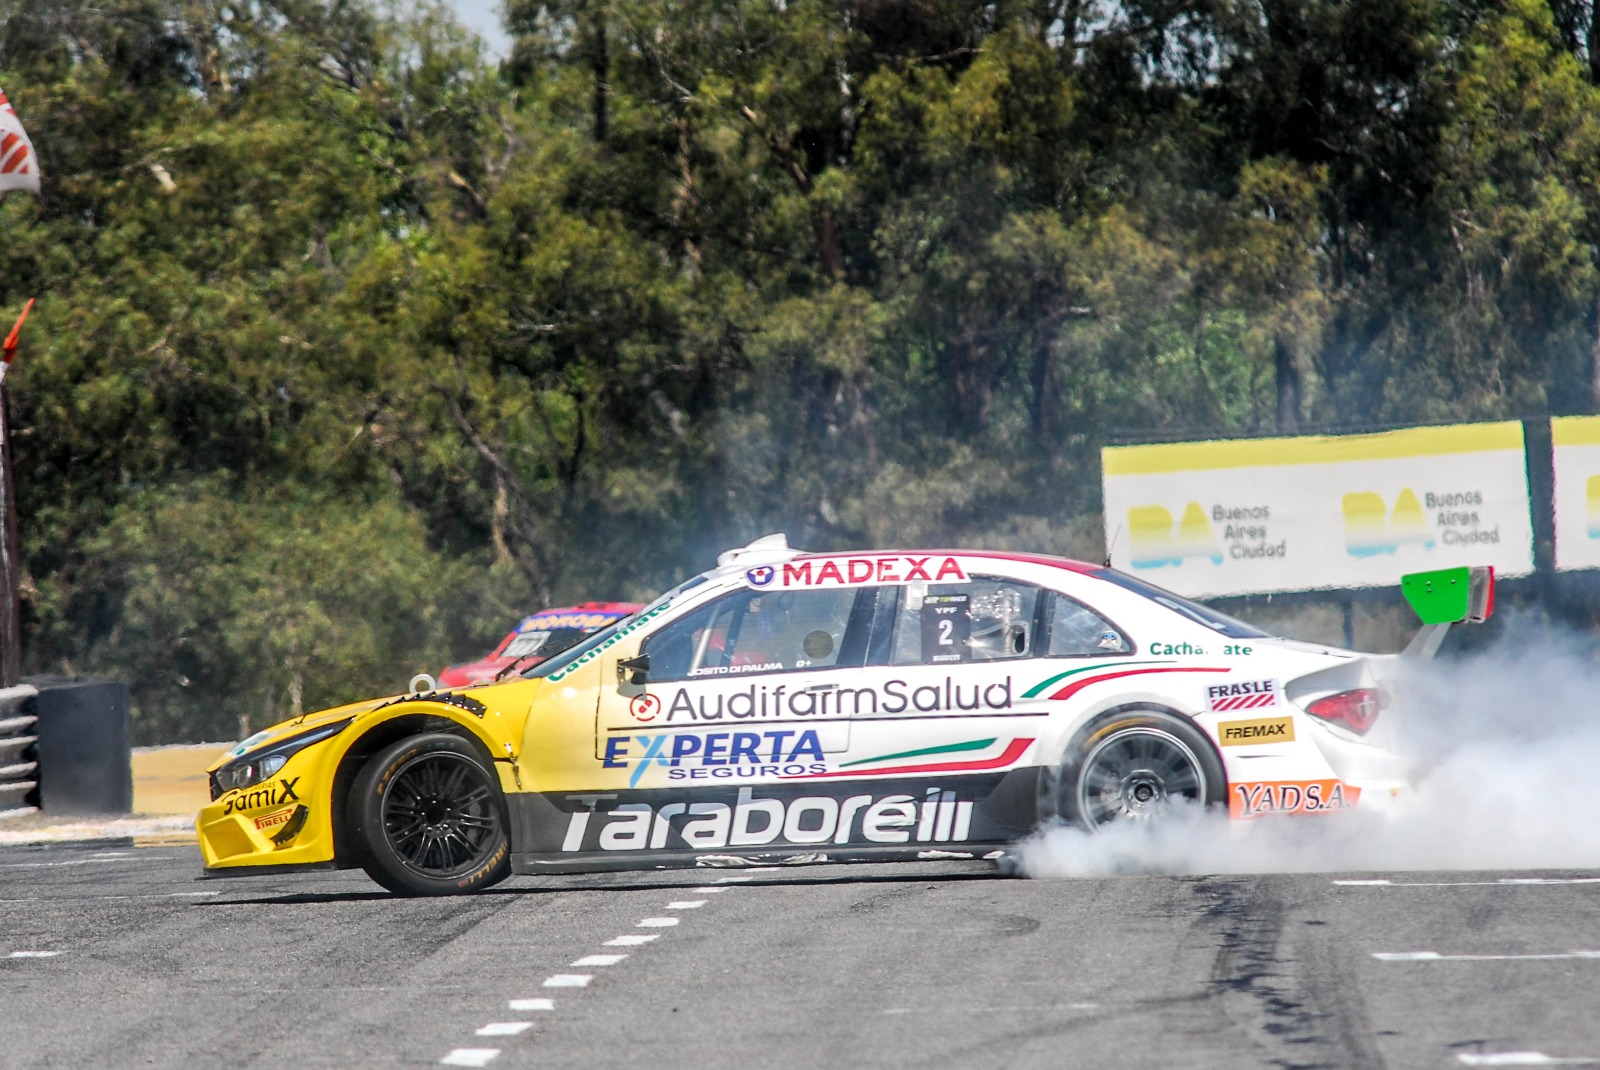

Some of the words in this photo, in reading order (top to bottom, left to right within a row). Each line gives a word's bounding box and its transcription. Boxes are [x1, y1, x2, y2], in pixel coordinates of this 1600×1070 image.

[1425, 490, 1482, 508] Buenos
[1212, 504, 1270, 521] Buenos
[1437, 510, 1480, 526] Aires
[1224, 524, 1266, 540] Aires
[1442, 523, 1500, 545] Ciudad
[1230, 540, 1286, 559] Ciudad
[783, 557, 965, 586] MADEXA
[939, 619, 953, 645] 2
[687, 666, 728, 677] JOSITO
[729, 665, 741, 673] DI
[742, 662, 783, 673] PALMA
[667, 676, 1011, 722] AudifarmSalud
[1226, 723, 1286, 739] FREMAX
[602, 730, 825, 789] EXPERTA
[669, 764, 827, 779] SEGUROS
